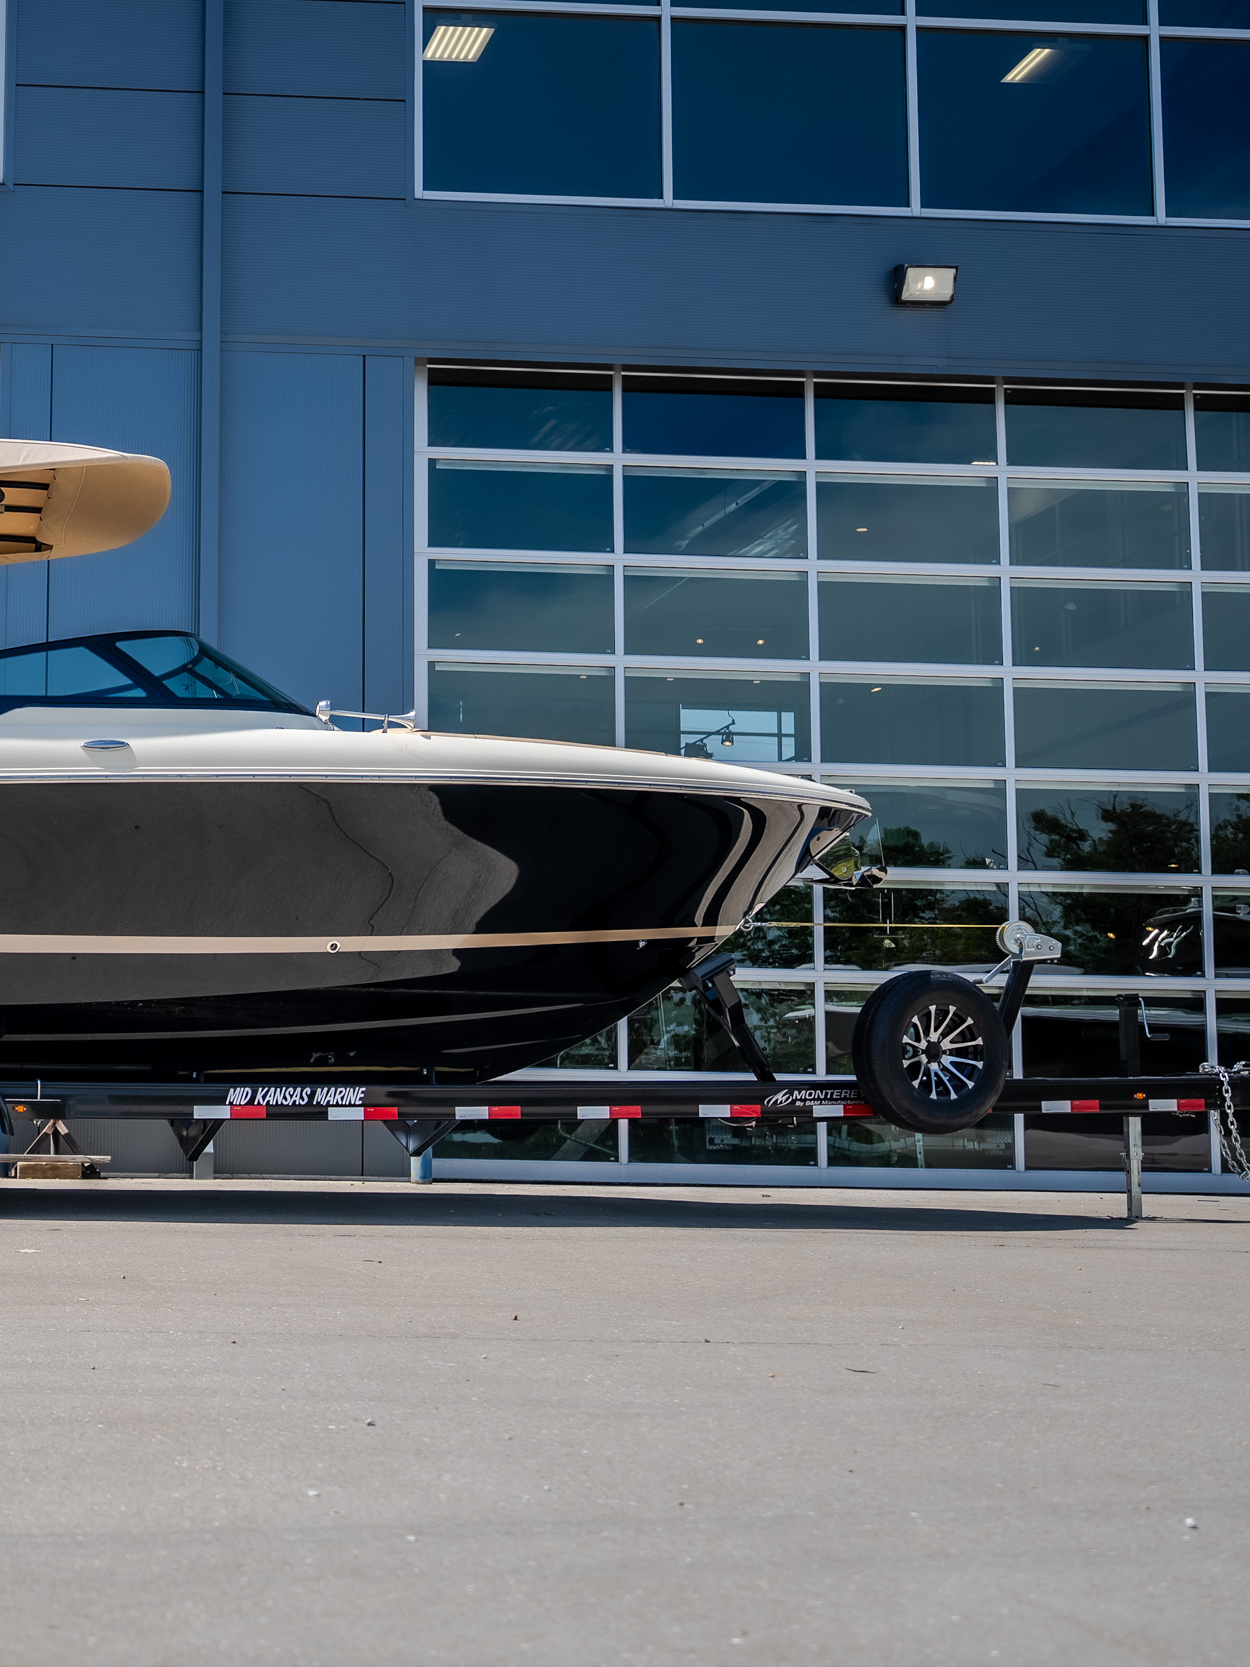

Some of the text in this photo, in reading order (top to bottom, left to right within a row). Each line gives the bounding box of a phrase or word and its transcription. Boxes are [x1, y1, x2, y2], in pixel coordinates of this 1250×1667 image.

[226, 1087, 366, 1106] MID KANSAS MARINE
